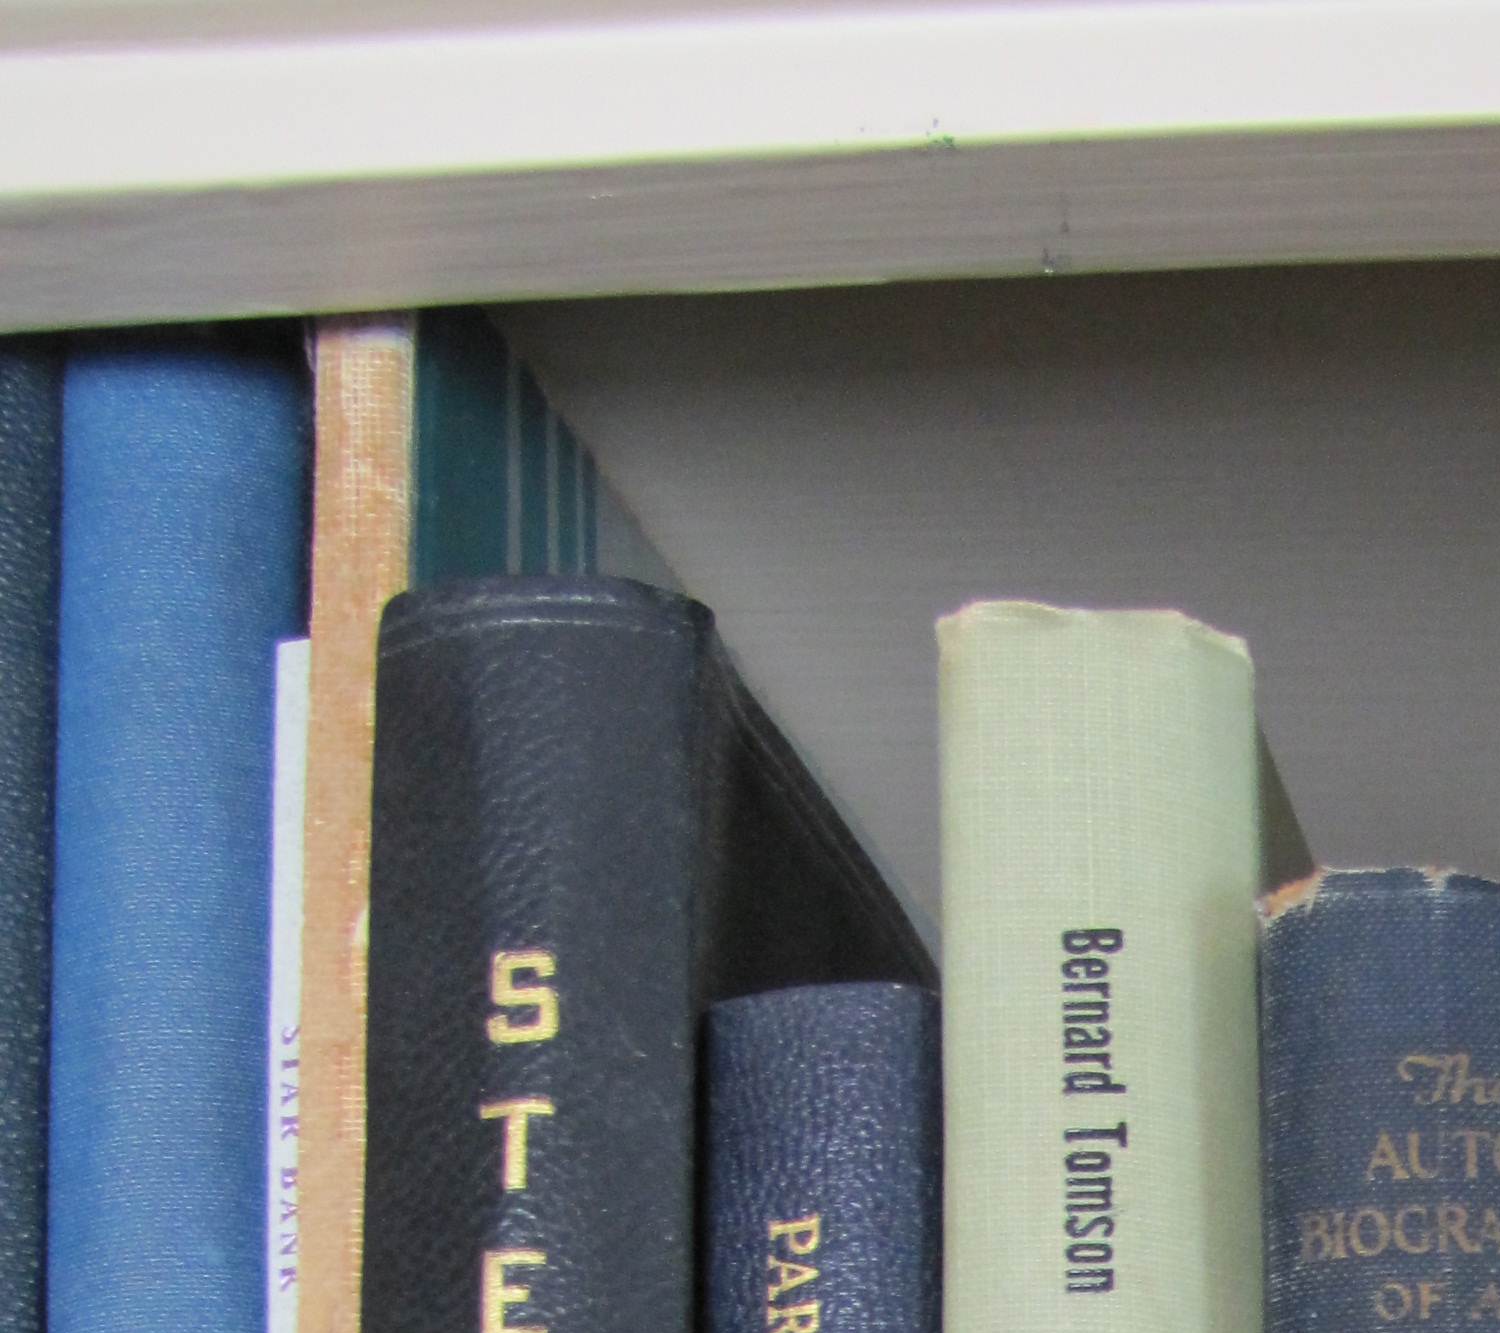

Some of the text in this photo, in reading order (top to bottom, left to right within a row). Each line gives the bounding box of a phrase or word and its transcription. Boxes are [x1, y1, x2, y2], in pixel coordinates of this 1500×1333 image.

[1062, 928, 1127, 1293] Bernard Tomson
[1374, 1282, 1446, 1322] OF
